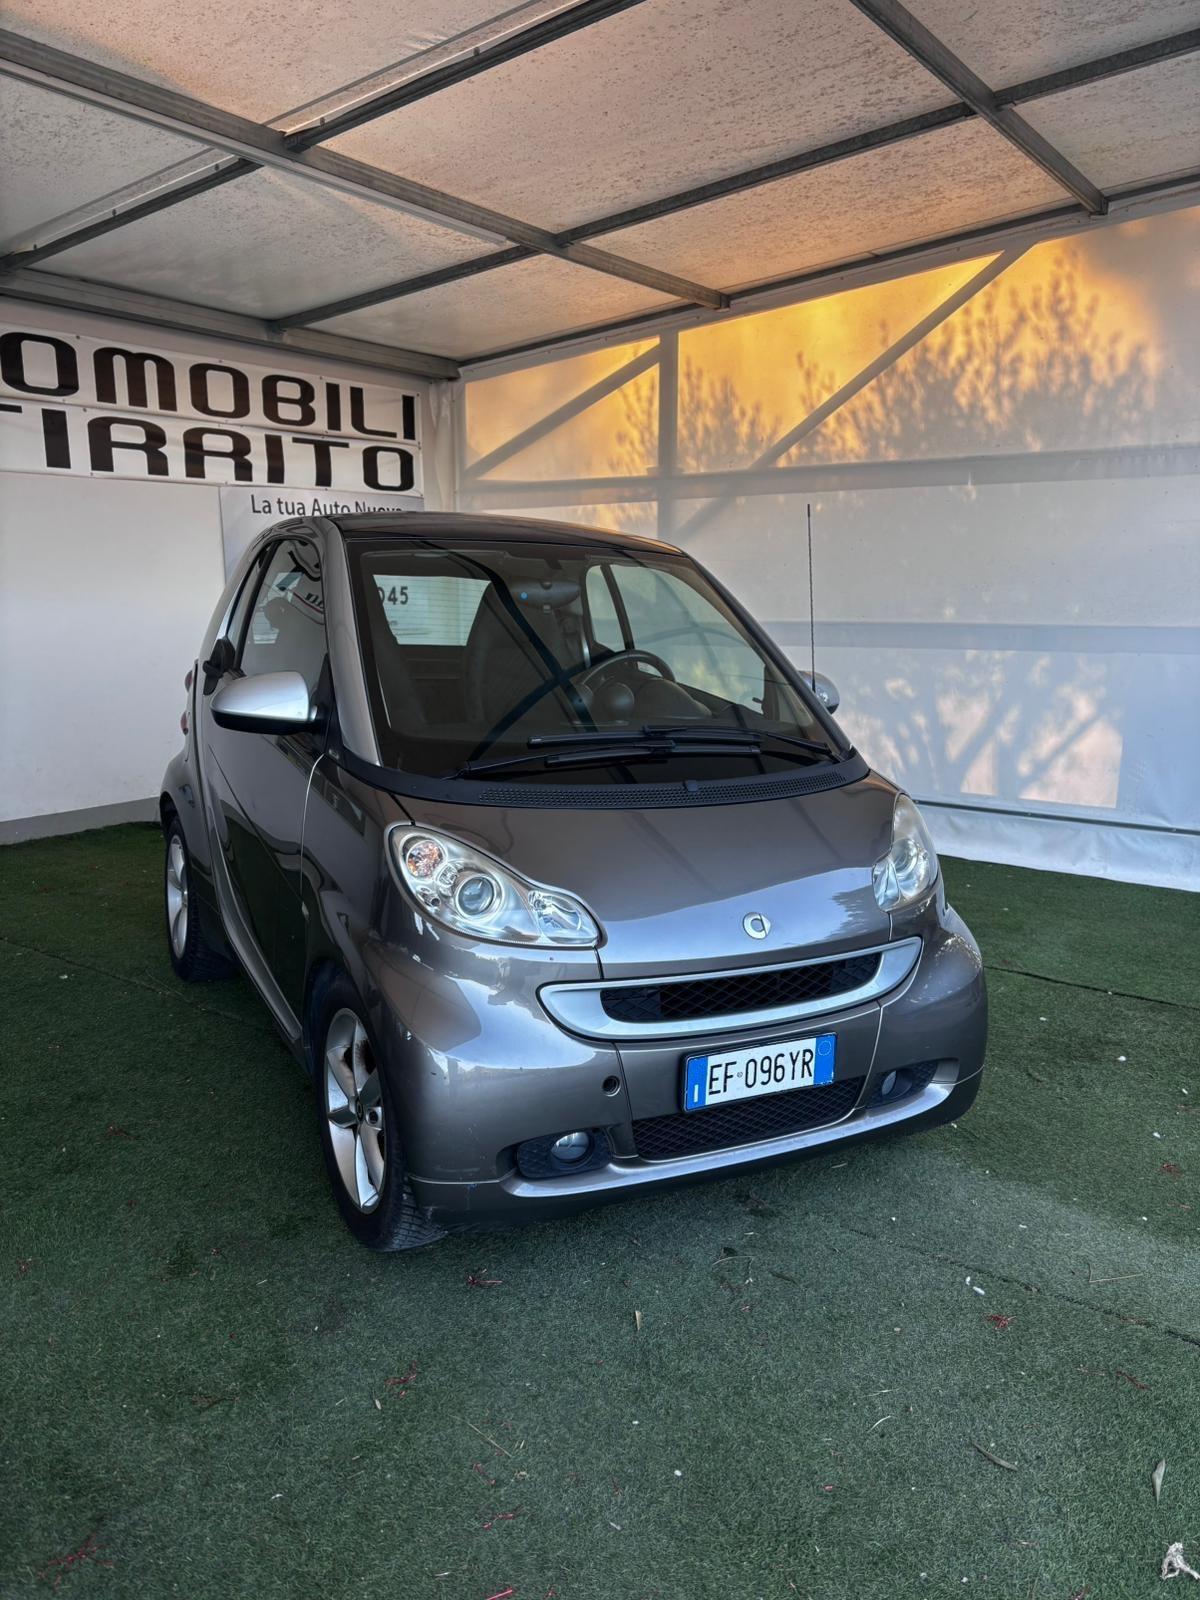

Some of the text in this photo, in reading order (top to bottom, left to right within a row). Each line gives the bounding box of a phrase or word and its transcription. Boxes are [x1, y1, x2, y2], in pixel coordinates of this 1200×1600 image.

[0, 332, 416, 441] OMOBILI
[0, 403, 415, 492] IRRITO
[251, 494, 272, 514] La
[277, 498, 306, 516] tua
[311, 498, 350, 517] Auto
